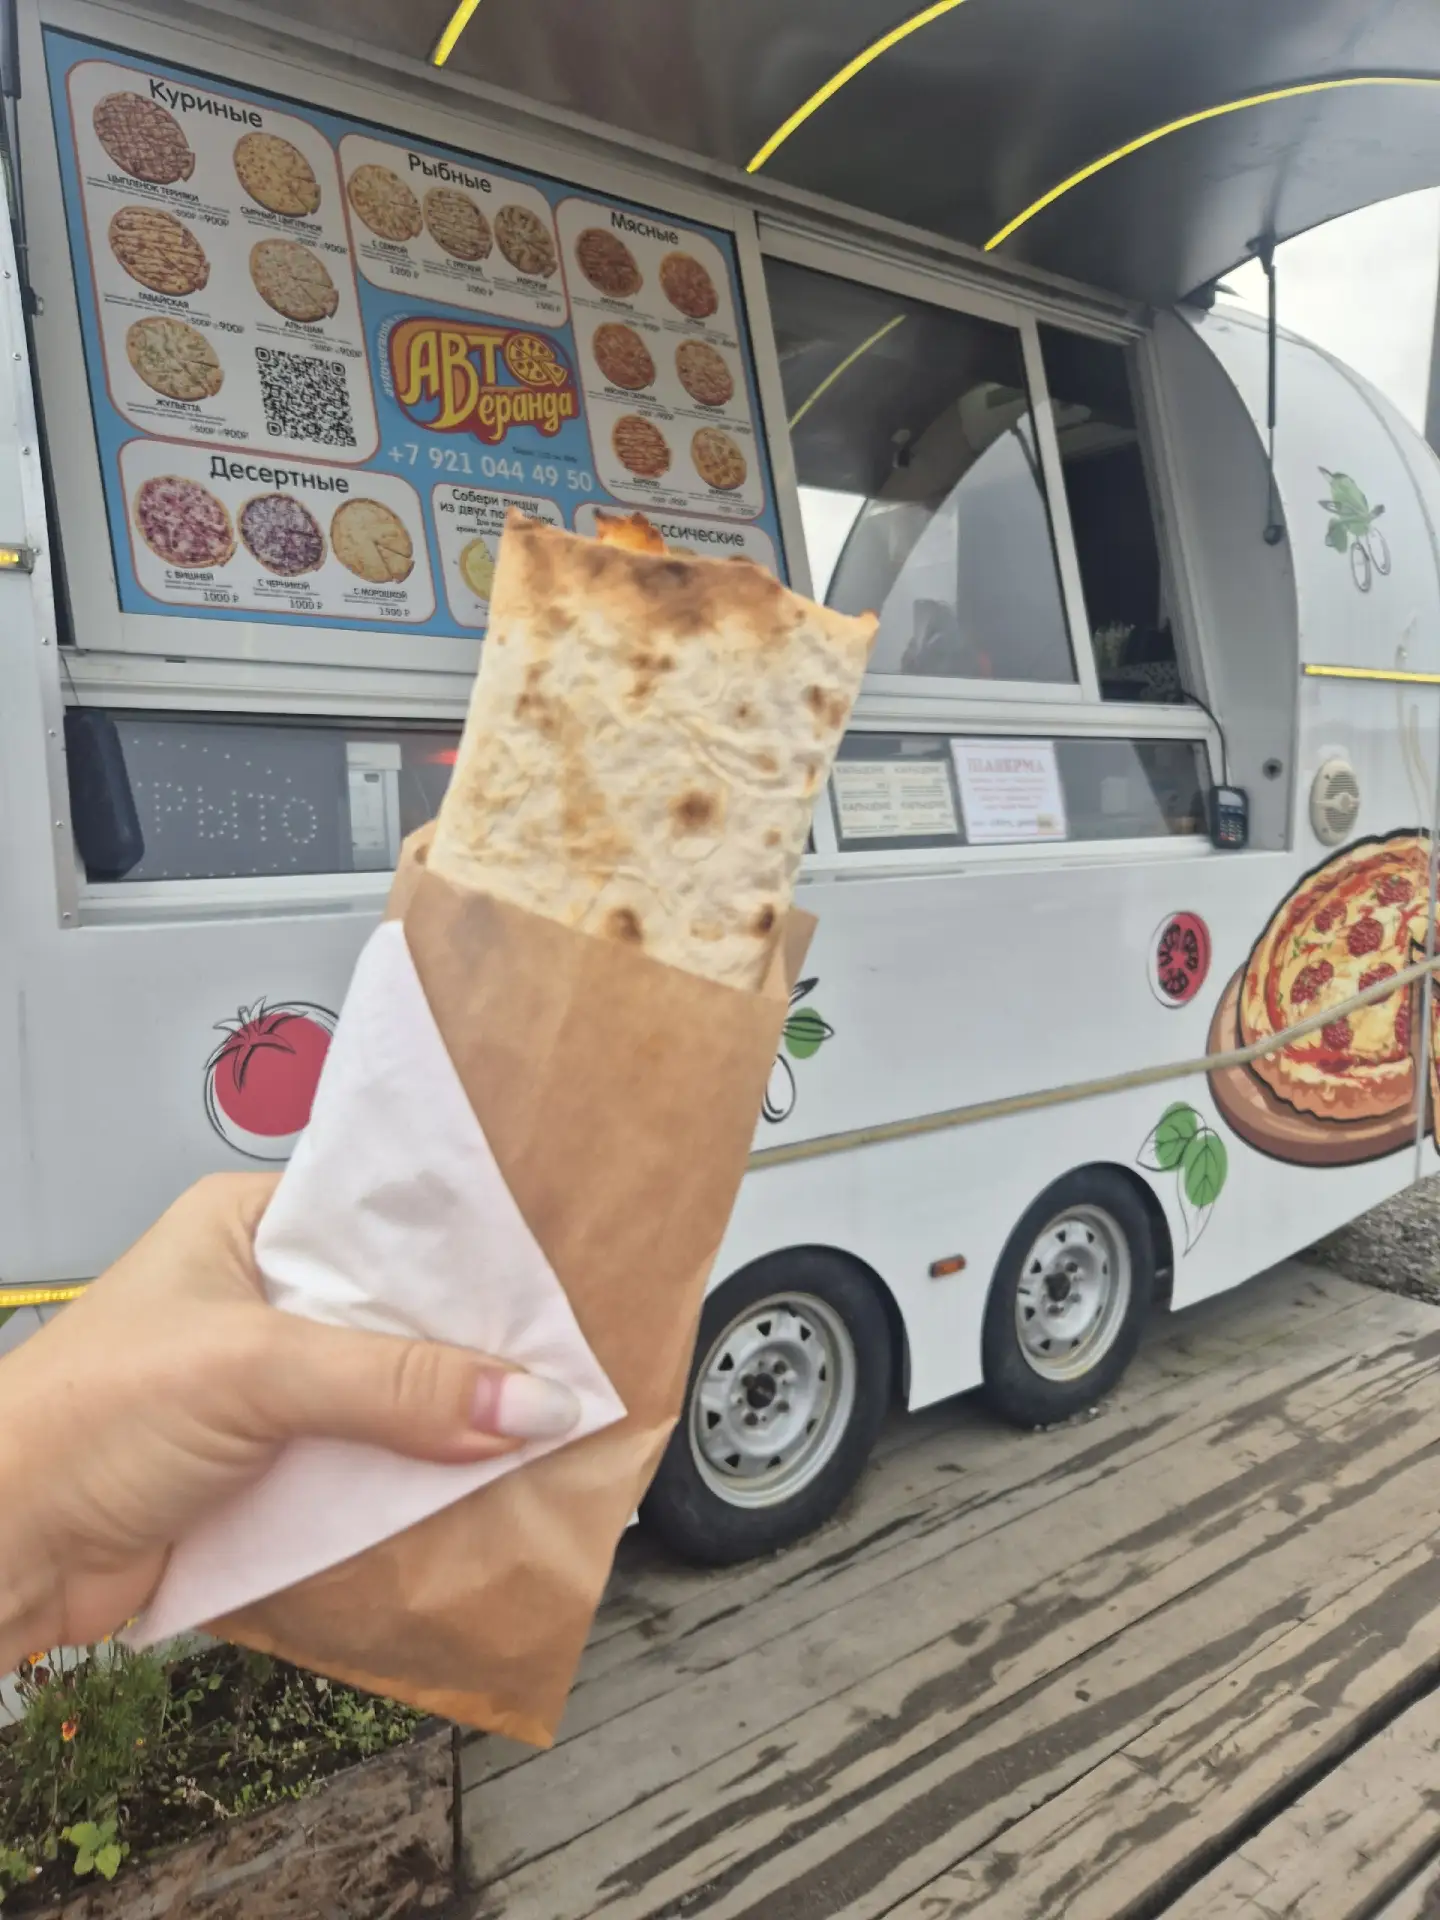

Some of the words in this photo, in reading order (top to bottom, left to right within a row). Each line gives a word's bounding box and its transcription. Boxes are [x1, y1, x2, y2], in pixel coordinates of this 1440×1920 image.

[149, 78, 263, 128] Куриные
[107, 174, 159, 192] ЦЫПЛЕНОК
[407, 152, 493, 193] Рыбные
[611, 211, 679, 245] Мясные
[209, 455, 350, 493] Десертные
[388, 444, 419, 466] +7
[428, 447, 473, 475] 921
[481, 455, 525, 483] 044
[532, 463, 559, 487] 49
[567, 471, 593, 492] 50
[440, 502, 455, 513] из
[459, 504, 487, 519] двух
[452, 488, 500, 508] Собери
[502, 498, 539, 514] пиццу
[651, 524, 745, 547] ссические
[174, 570, 215, 581] ВИШНЕЙ
[203, 592, 230, 603] 1000
[289, 599, 315, 610] 1000
